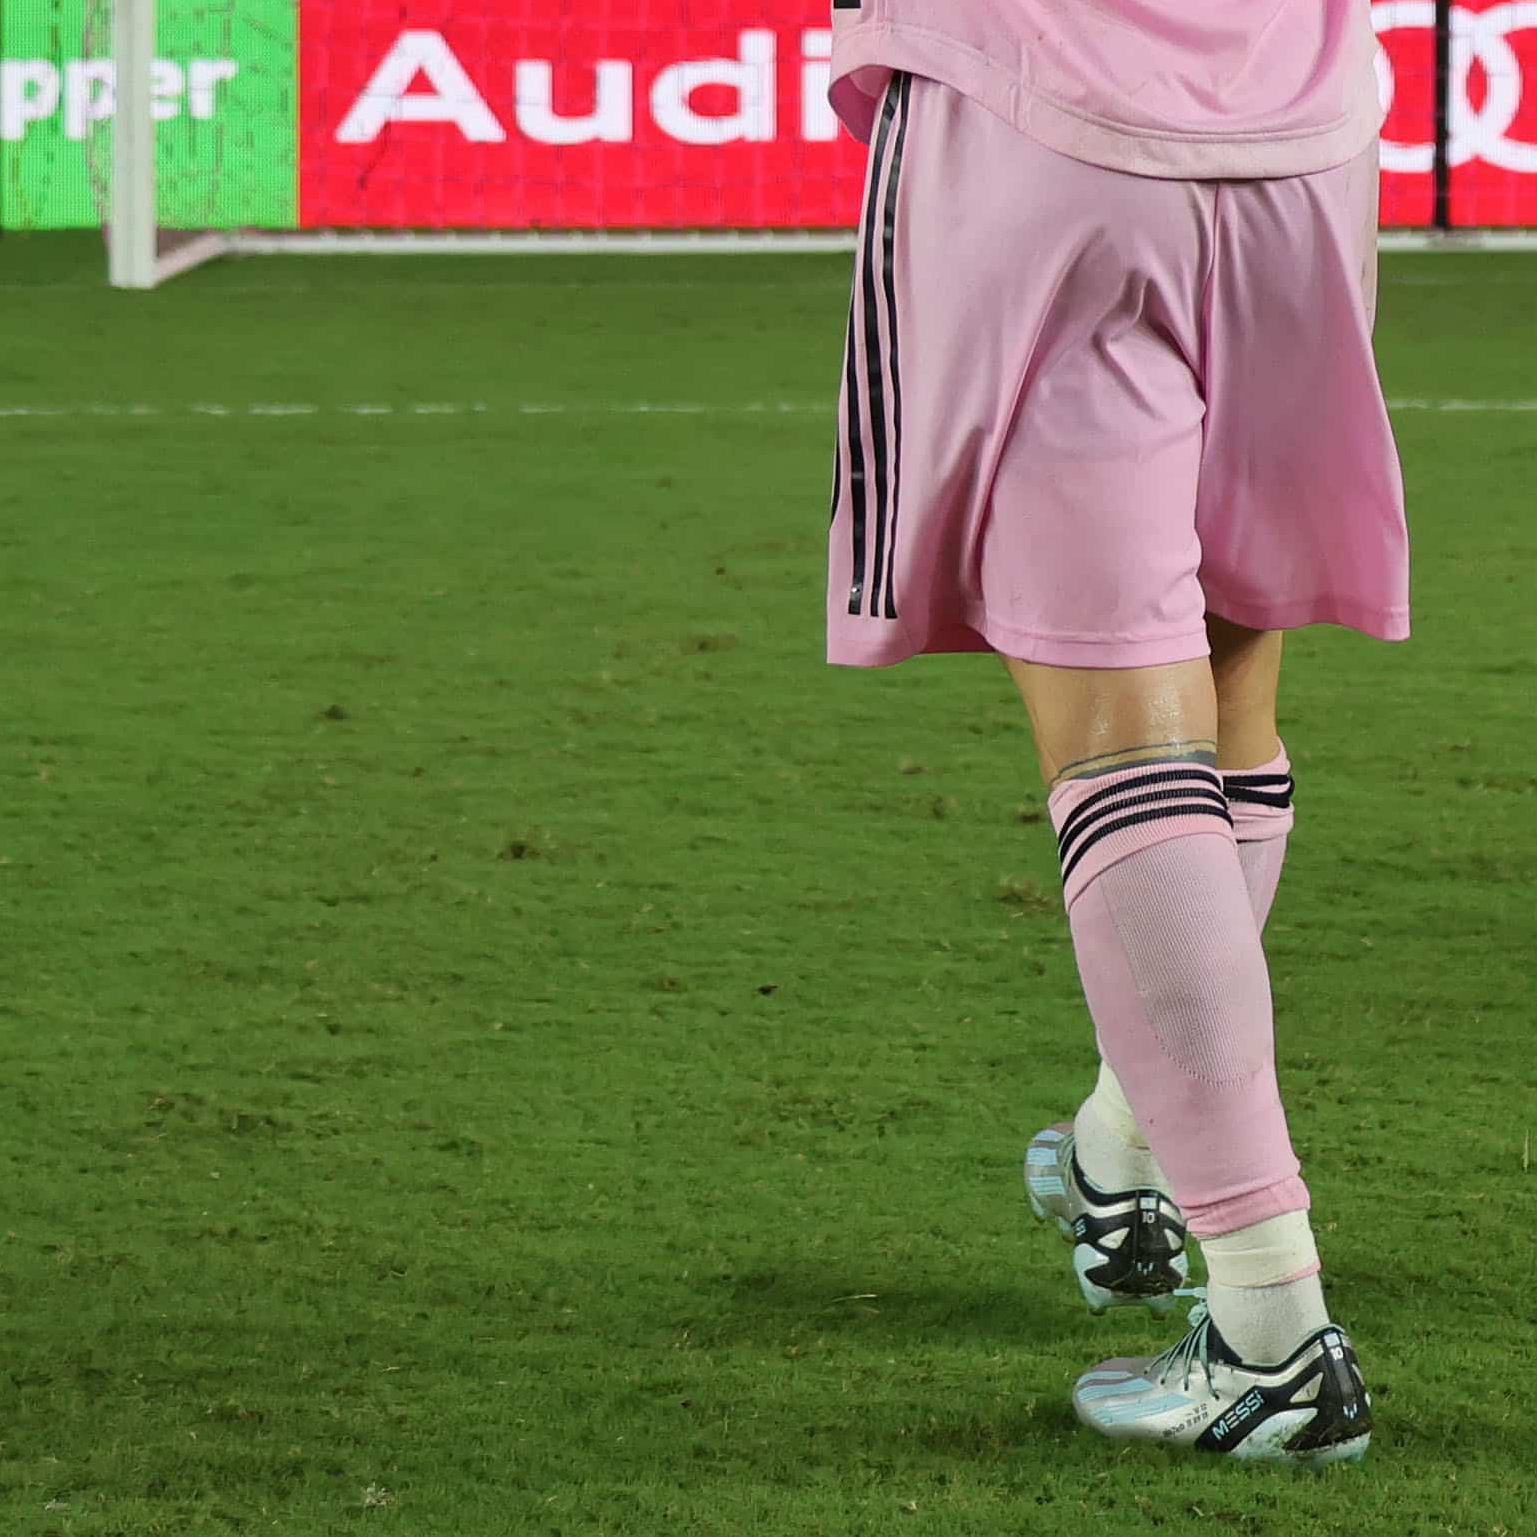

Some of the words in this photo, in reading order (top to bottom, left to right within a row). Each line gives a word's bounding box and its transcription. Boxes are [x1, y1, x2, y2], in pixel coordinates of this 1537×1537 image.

[334, 28, 839, 146] Audi
[1142, 1212, 1157, 1224] 10
[1329, 1346, 1344, 1361] 10
[1212, 1390, 1265, 1441] MESSI
